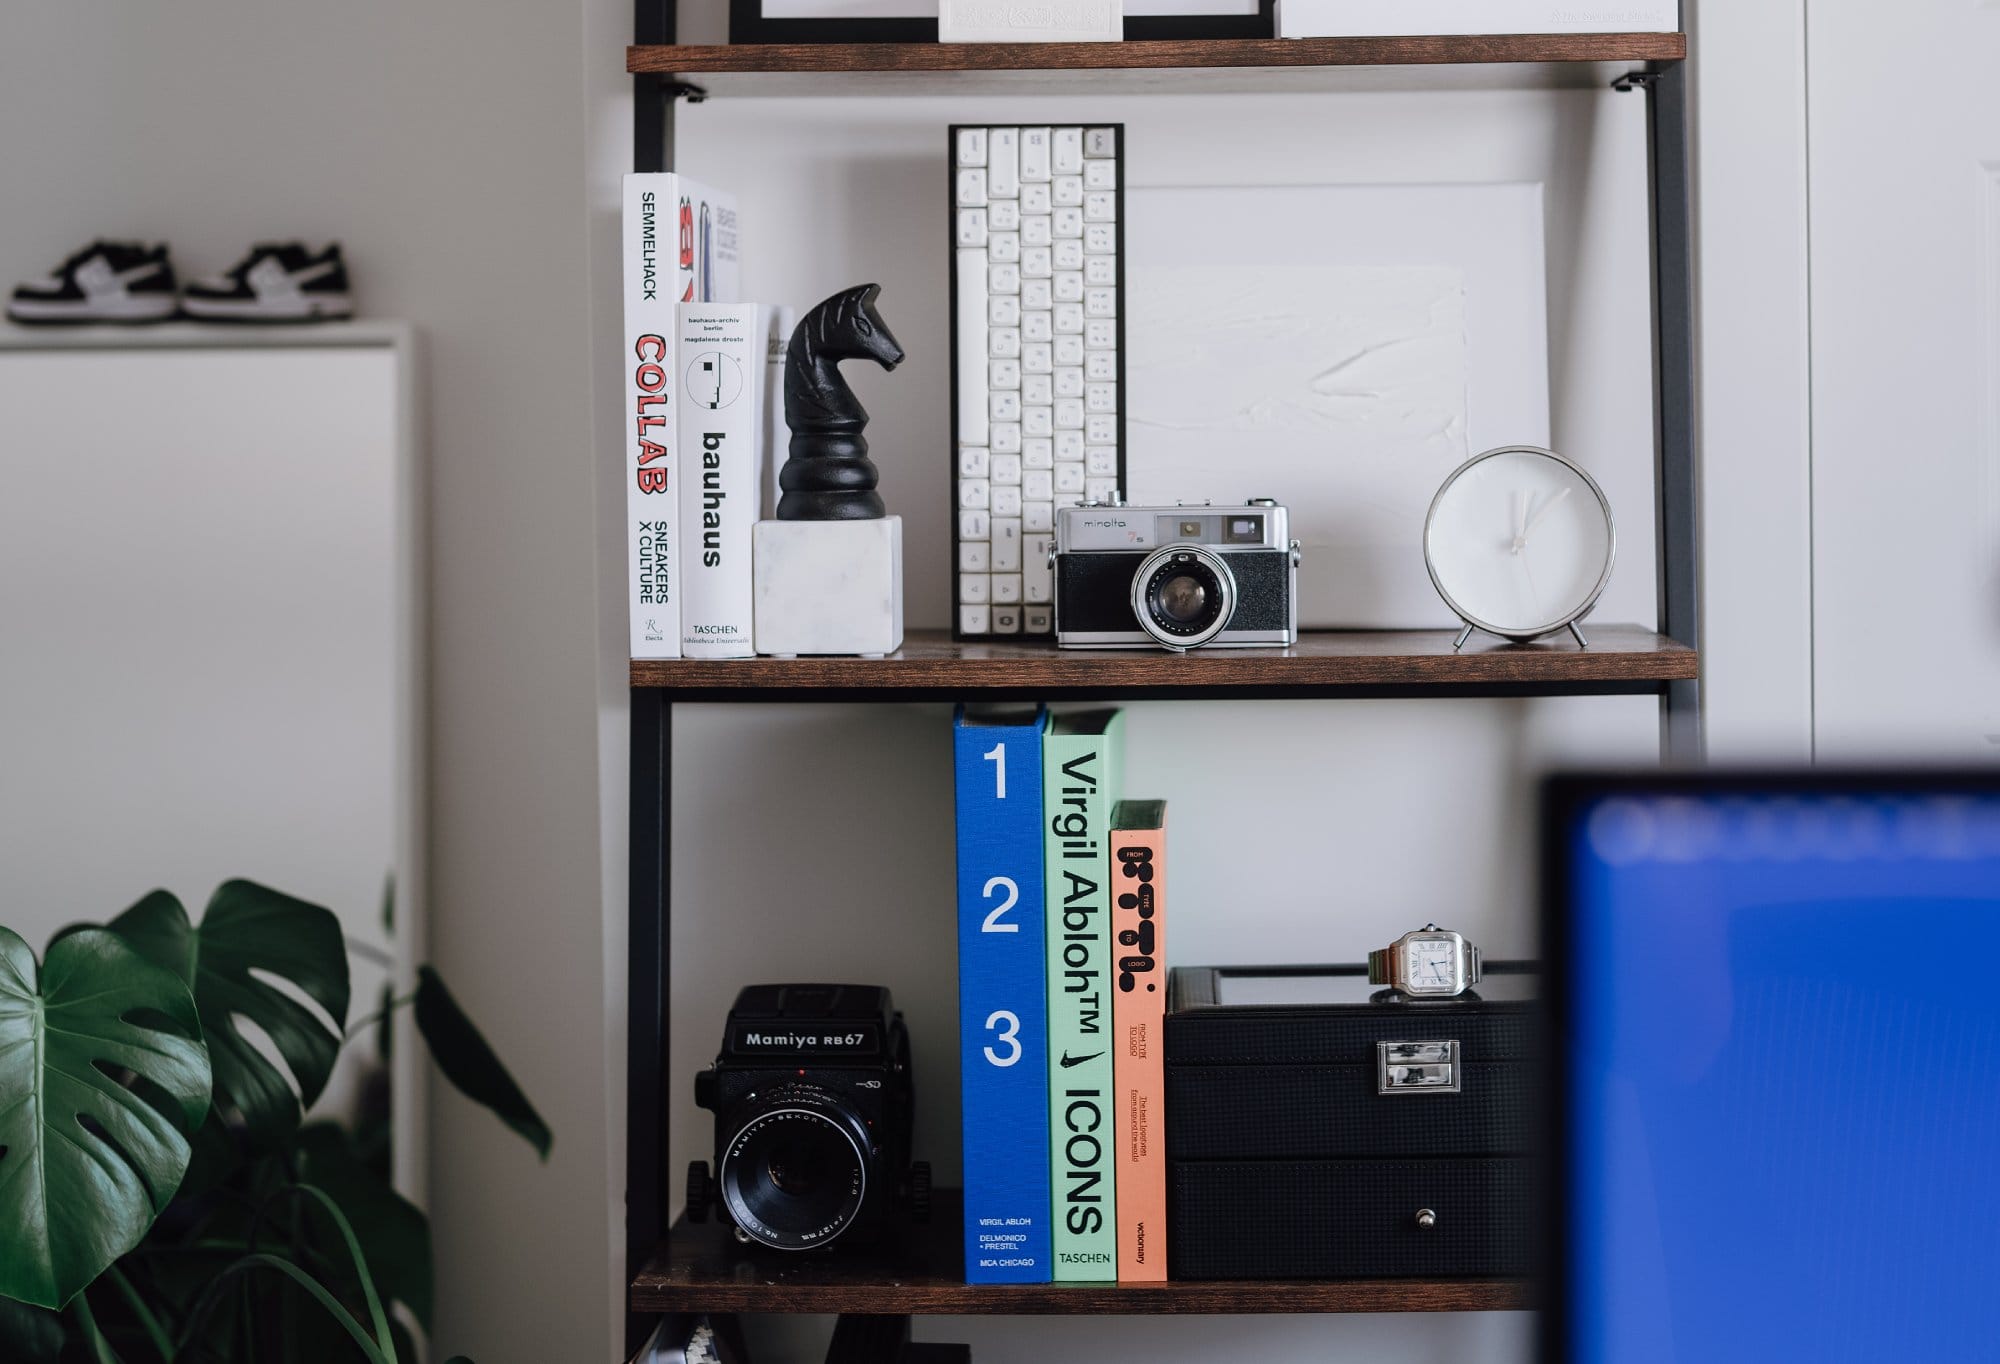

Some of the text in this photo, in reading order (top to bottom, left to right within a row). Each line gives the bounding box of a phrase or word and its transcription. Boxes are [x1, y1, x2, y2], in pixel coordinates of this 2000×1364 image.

[642, 191, 656, 302] SEMMELHACK
[684, 335, 720, 343] magdalena
[635, 333, 669, 496] COLLAB
[702, 431, 727, 569] bauhaus
[1084, 518, 1126, 528] minolta
[639, 520, 653, 605] X CULTURE
[654, 520, 669, 605] SNEAKERS
[693, 625, 738, 635] TASCHEN
[983, 742, 1007, 799] 1
[1051, 750, 1098, 859] Virgil
[981, 876, 1019, 933] 2
[746, 1032, 865, 1049] Mamiya RB67
[983, 1010, 1022, 1067] 3
[1130, 1026, 1138, 1057] TO LOGO
[1139, 1023, 1147, 1060] FROM TYPE
[1139, 1096, 1147, 1108] The
[1139, 1109, 1147, 1123] best
[1131, 1089, 1139, 1162] from around the world
[1064, 1089, 1103, 1236] ICONS
[979, 1217, 1032, 1226] VIRGIL ABLOH
[979, 1234, 1027, 1242] DELMONICO
[984, 1242, 1019, 1251] PRESTEL
[1059, 1253, 1111, 1264] TASCHEN
[1136, 1222, 1145, 1265] victionary
[979, 1258, 1035, 1267] MCA CHICAGO
